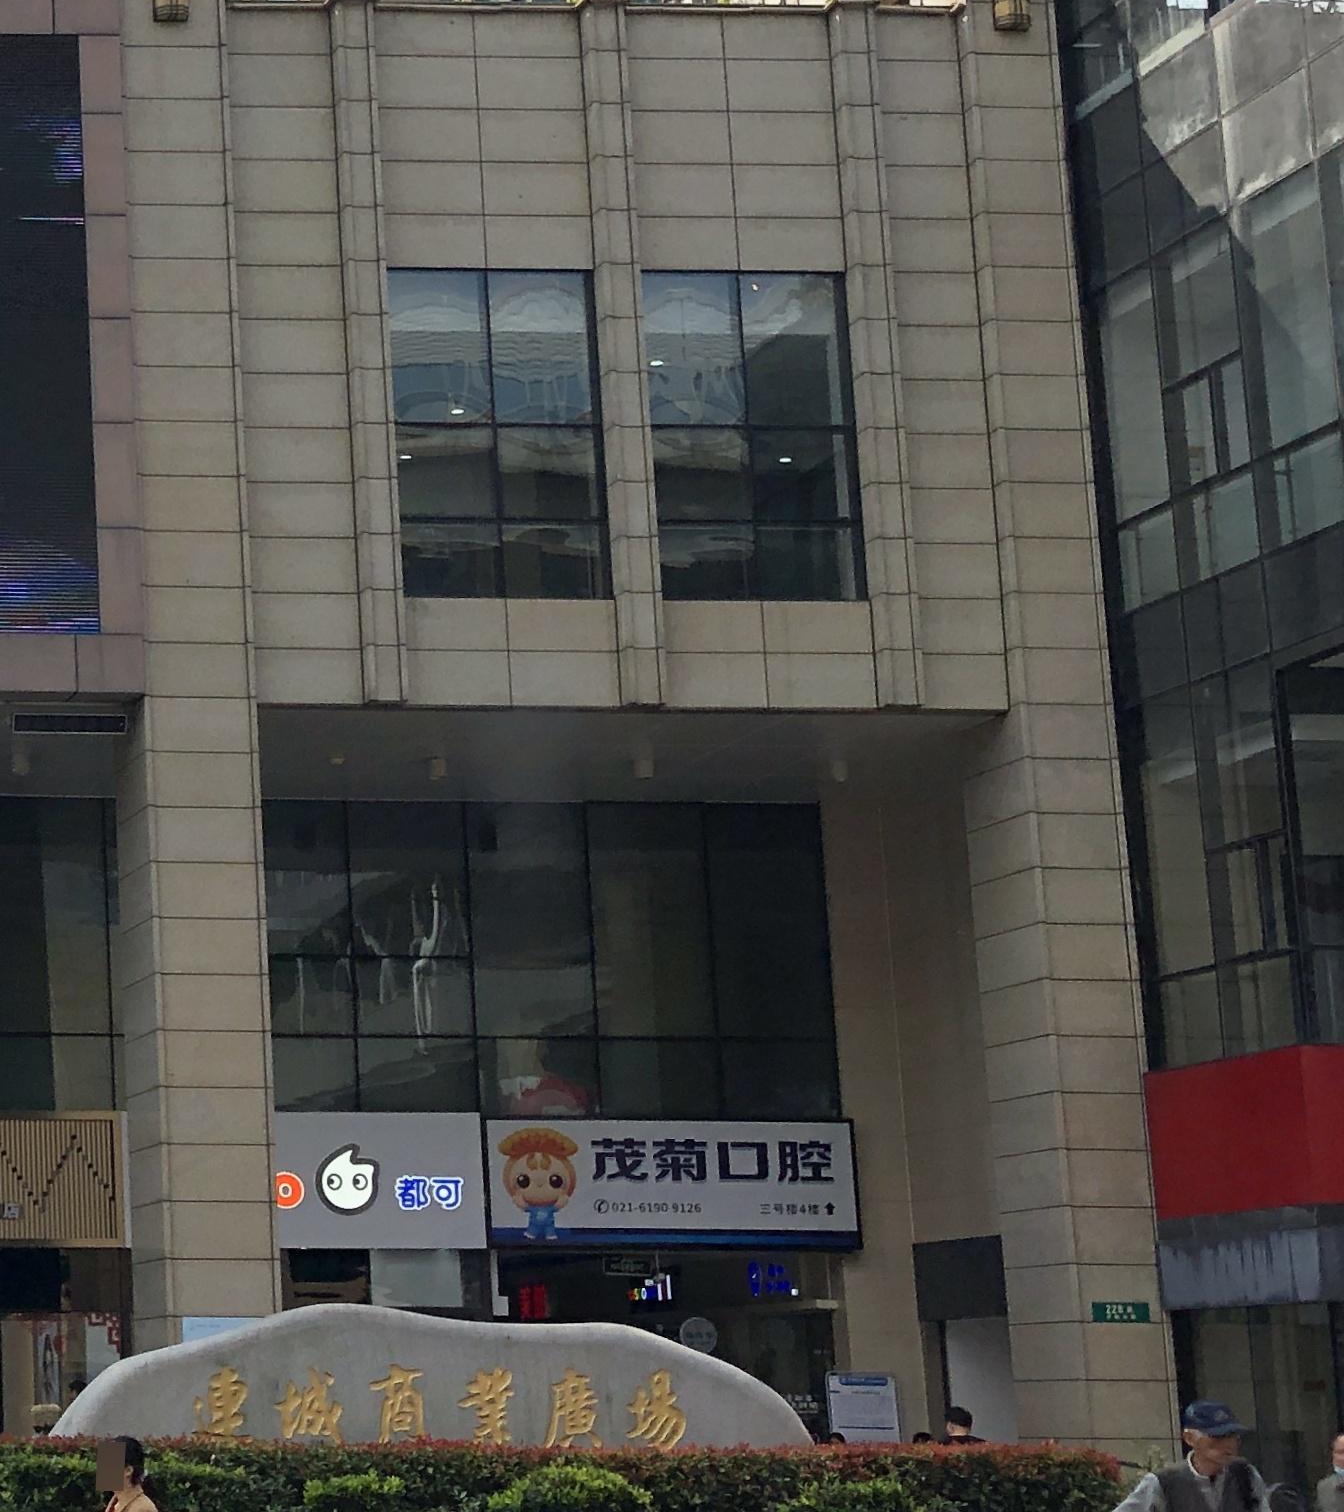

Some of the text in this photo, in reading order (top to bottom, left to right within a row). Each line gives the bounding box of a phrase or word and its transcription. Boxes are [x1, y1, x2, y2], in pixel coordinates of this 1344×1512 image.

[590, 1138, 834, 1182] 茂菊口腔
[395, 1175, 464, 1211] 都可
